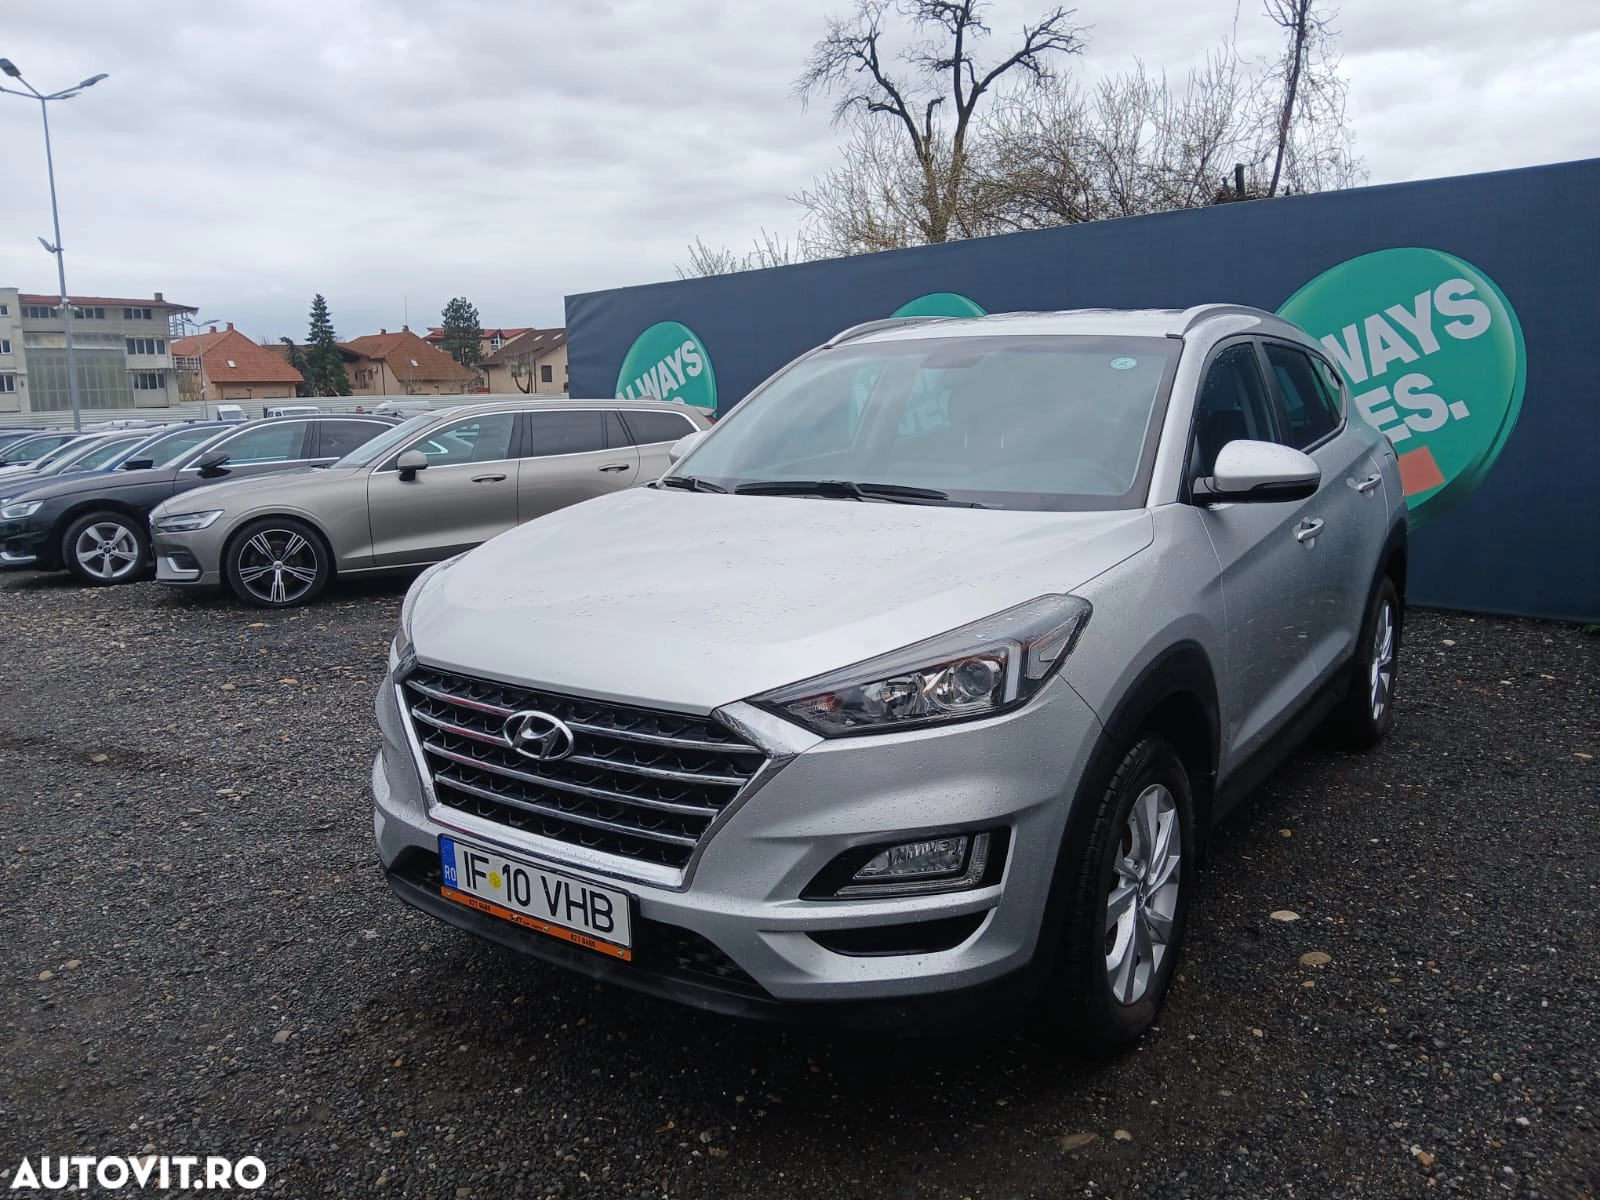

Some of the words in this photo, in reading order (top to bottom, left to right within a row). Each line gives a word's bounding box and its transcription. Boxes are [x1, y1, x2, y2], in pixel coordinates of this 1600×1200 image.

[616, 340, 703, 400] WAYS
[444, 865, 457, 881] RO
[463, 850, 490, 890] IF
[502, 863, 531, 907] 10
[540, 875, 614, 933] VHB
